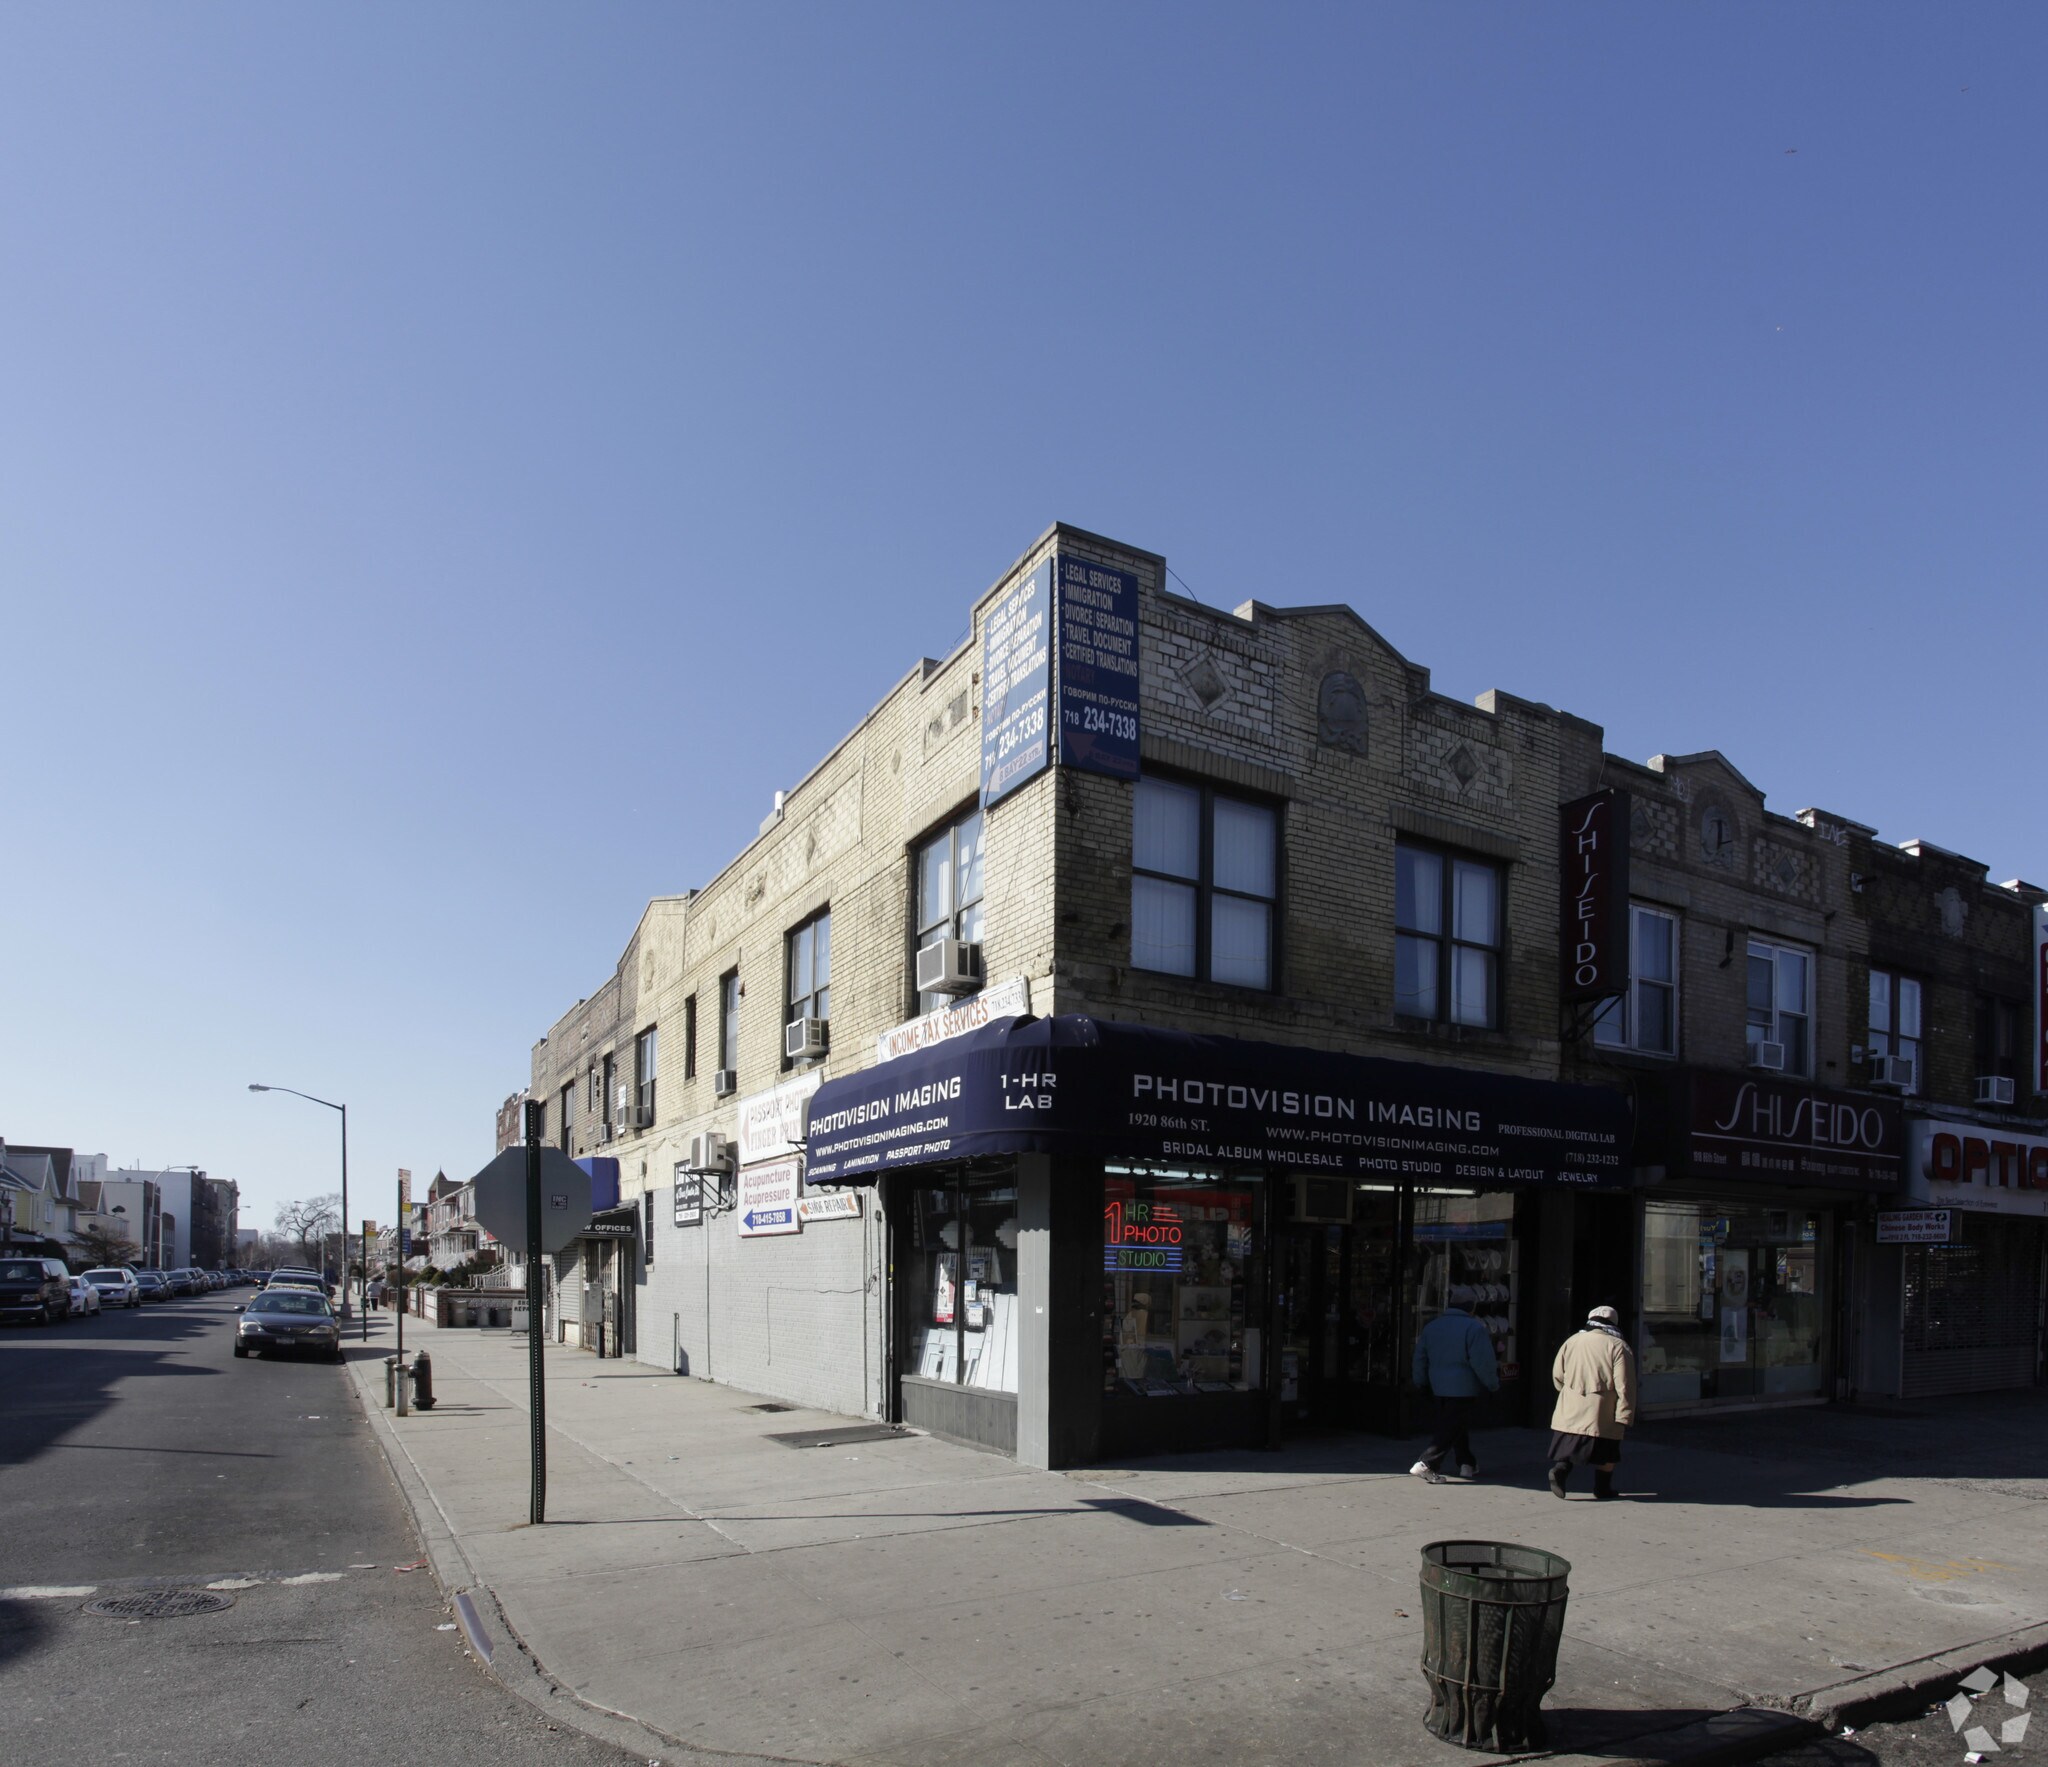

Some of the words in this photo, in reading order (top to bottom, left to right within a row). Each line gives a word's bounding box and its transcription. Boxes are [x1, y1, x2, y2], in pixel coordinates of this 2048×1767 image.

[1065, 563, 1087, 584] LEGAL
[1089, 570, 1122, 595] SERVICES
[1065, 583, 1113, 611] IMMIGRATION
[990, 607, 1007, 635] LEGAL
[1065, 623, 1091, 645] TRAVEL
[1093, 630, 1132, 656] DOCUMENT
[1010, 645, 1046, 689] TRANSLATIONS
[1065, 642, 1094, 666] CERTIFIED
[1096, 650, 1138, 678] TRANSLATIONS
[988, 662, 1007, 691] TRAVEL
[1011, 688, 1046, 722] ПО-РУССКИ
[1063, 685, 1097, 703] ГОВОРИМ
[1098, 694, 1138, 712] ПО-РУССКИ
[999, 707, 1044, 759] 234-7338
[1064, 709, 1080, 725] 718
[1083, 706, 1137, 740] 234-7338
[1572, 802, 1604, 986] SHISEIDO
[889, 1026, 921, 1057] INCOME
[921, 1017, 940, 1045] TAX
[943, 997, 989, 1036] SERVICES
[1000, 1073, 1057, 1089] 1-HR
[810, 1097, 890, 1138] PHOTOVISION
[895, 1076, 962, 1113] IMAGING
[1005, 1094, 1052, 1110] LAB
[1133, 1074, 1355, 1121] PHOTOVISION
[1368, 1100, 1481, 1132] IMAGING
[1714, 1082, 1884, 1149] SHISEIDO
[750, 1126, 777, 1152] FINGER
[779, 1119, 802, 1143] PRIN
[815, 1116, 949, 1158] WWW.PHOTOVISIONIMAGING.COM
[1128, 1112, 1157, 1127] 1920
[1160, 1115, 1188, 1130] 86th
[1190, 1118, 1211, 1132] ST.
[1498, 1124, 1564, 1139] PROFESSIONAL
[1565, 1130, 1599, 1142] DIGITAL
[1600, 1133, 1616, 1144] LAB
[1265, 1126, 1500, 1157] WWW.PHOTOVISIONIMAGING.COM
[808, 1163, 837, 1177] SCANNING
[843, 1154, 880, 1170] LAMINATION
[886, 1145, 923, 1161] PASSPORT
[924, 1139, 951, 1154] PHOTO
[1163, 1141, 1213, 1157] BRIDAL
[1217, 1145, 1262, 1160] ALBUM
[1267, 1148, 1344, 1167] WHOLESALE
[1359, 1156, 1398, 1171] PHOTO
[1401, 1160, 1442, 1174] STUDIO
[1455, 1164, 1495, 1178] DESIGN
[1498, 1166, 1505, 1178] &
[1508, 1168, 1544, 1180] LAYOUT
[1557, 1171, 1598, 1183] JEWELRY
[1565, 1152, 1585, 1165] (718)
[1586, 1153, 1619, 1166] 232-1232
[744, 1169, 791, 1189] Acupuncture
[744, 1187, 790, 1207] Acupressure
[825, 1198, 848, 1213] REPAIR
[595, 1224, 632, 1232] OFFICES
[1104, 1201, 1121, 1244] 1
[1125, 1203, 1149, 1222] HR
[1880, 1222, 1906, 1231] Chinese
[1908, 1223, 1924, 1232] Body
[1925, 1222, 1945, 1230] Works
[1902, 1212, 1923, 1221] GARDEN
[1124, 1226, 1182, 1244] PHOTO
[1117, 1250, 1166, 1267] STUDIO
